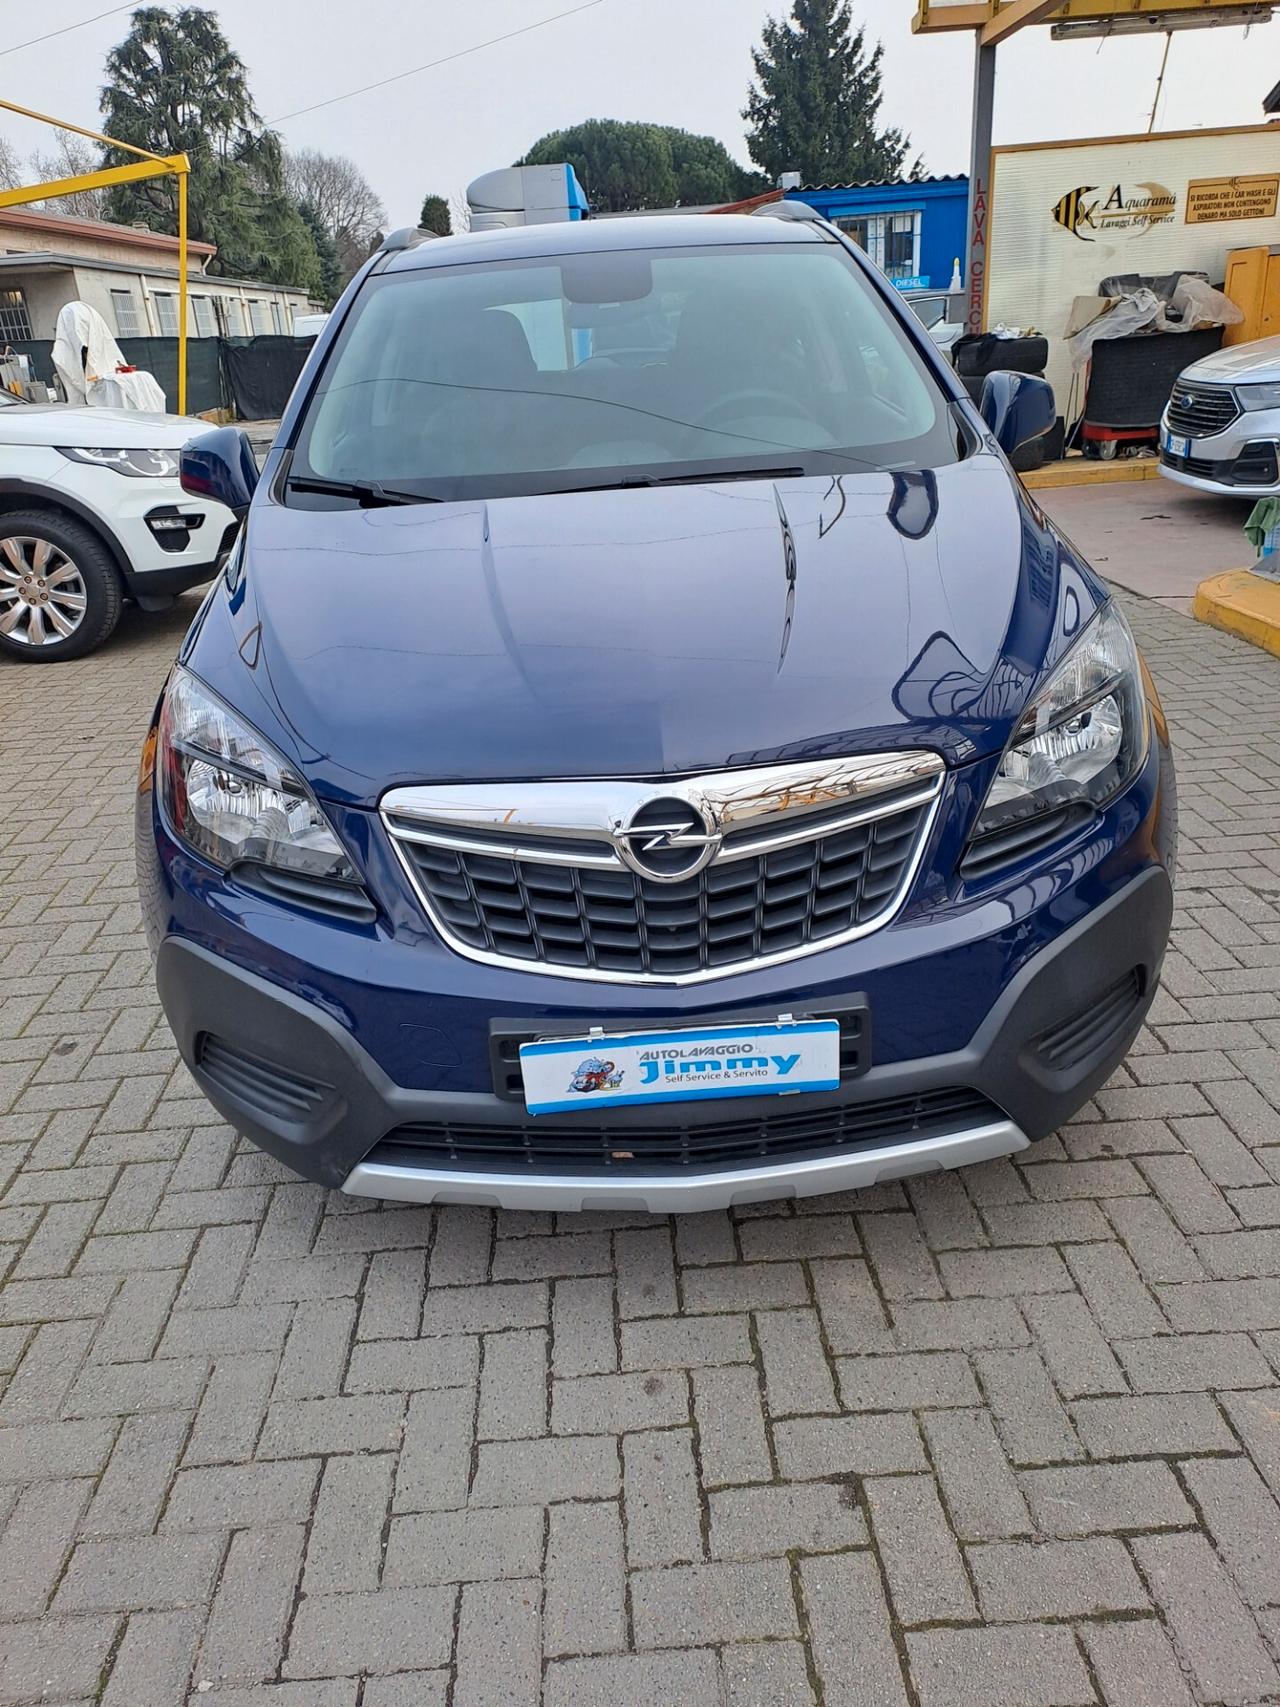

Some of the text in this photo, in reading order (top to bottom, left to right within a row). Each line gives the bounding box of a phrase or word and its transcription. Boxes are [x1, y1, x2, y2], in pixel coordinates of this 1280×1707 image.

[1196, 193, 1219, 202] RICORDA
[1220, 191, 1230, 200] CHE
[1235, 190, 1246, 199] CAR
[1246, 189, 1262, 198] WASH
[973, 178, 986, 245] LAVA
[1193, 198, 1272, 212] ASPIRATORI NON CONTENGONO
[1100, 213, 1175, 229] Lavaggi Self Service
[1197, 212, 1219, 220] DENARO
[1228, 210, 1242, 218] SOLO
[1242, 208, 1265, 216] GETTONI
[895, 279, 923, 288] DIESEL
[639, 1043, 754, 1061] AUTOLAVAGGIO
[665, 1075, 684, 1084] Self
[686, 1072, 722, 1082] Service
[733, 1068, 768, 1078] Servito
